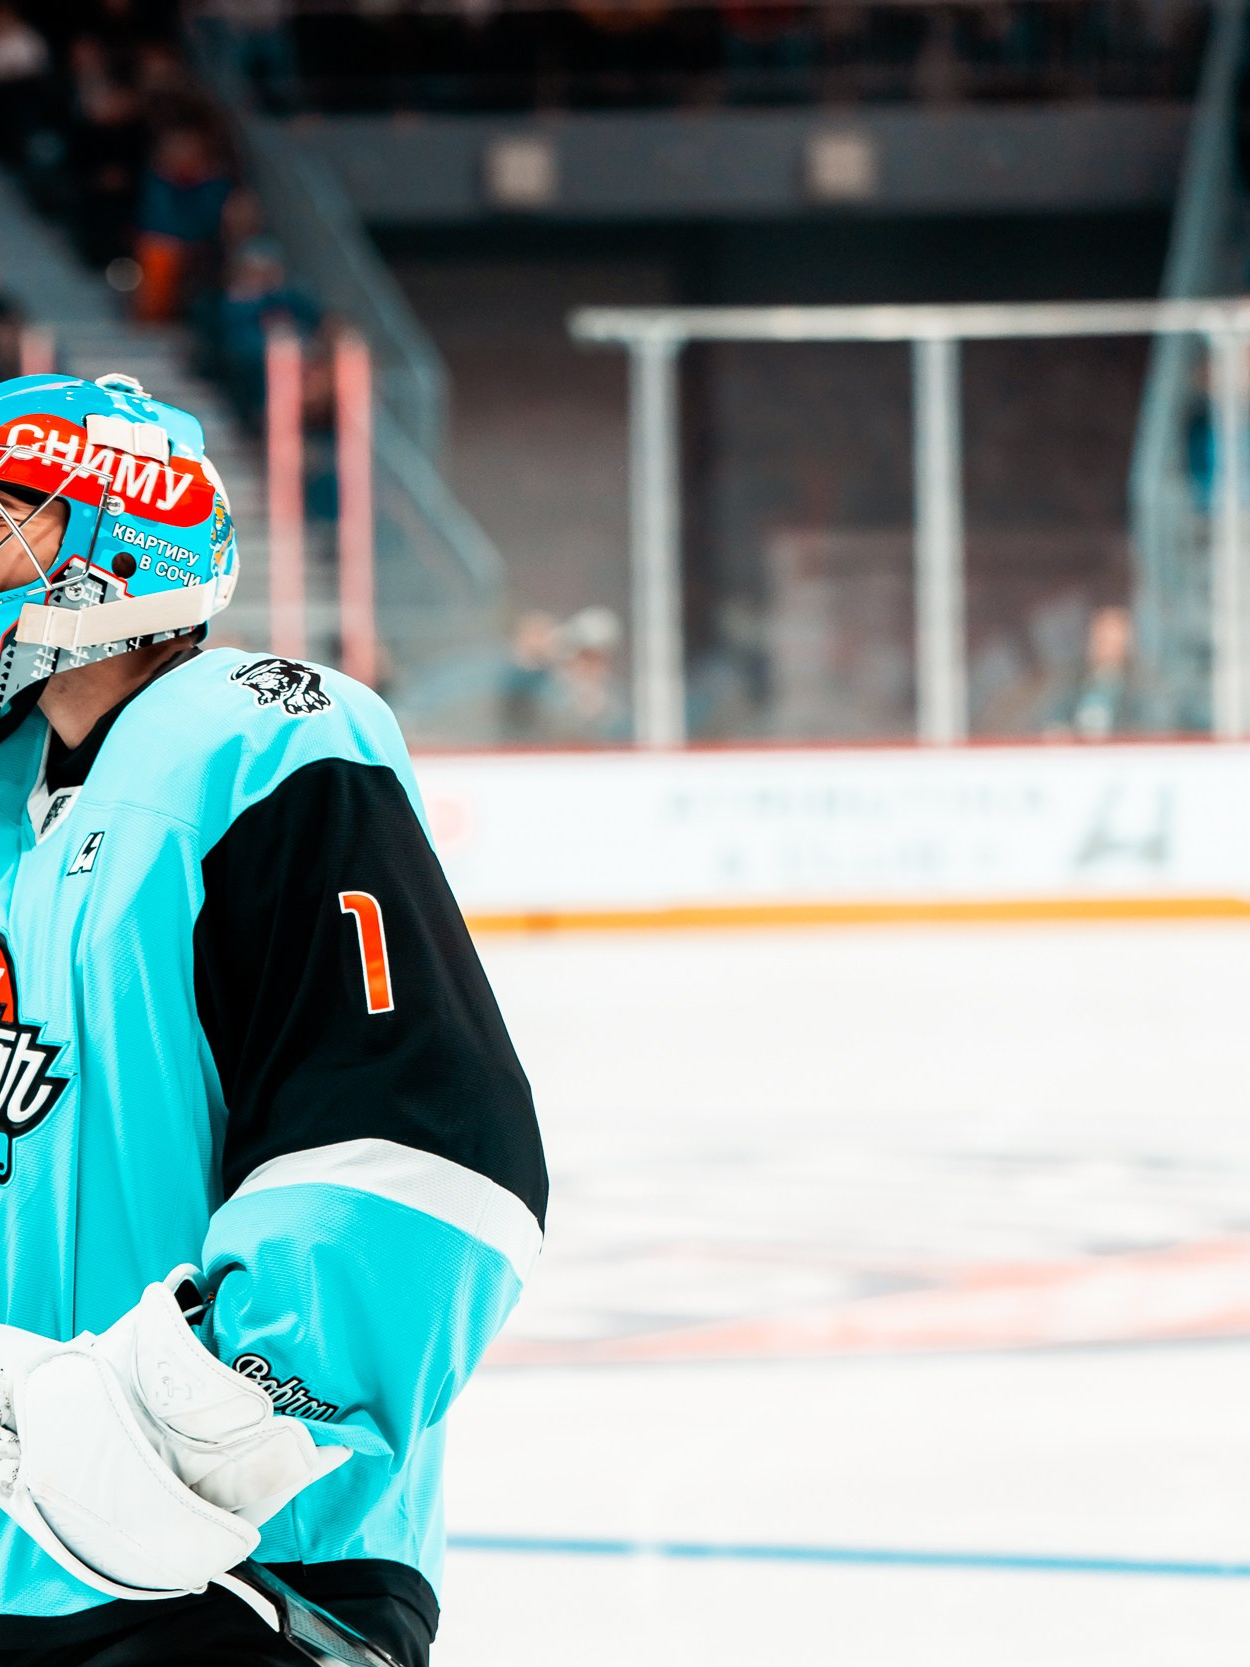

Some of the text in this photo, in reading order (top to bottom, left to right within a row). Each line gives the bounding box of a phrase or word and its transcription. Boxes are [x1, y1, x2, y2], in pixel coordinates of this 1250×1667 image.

[7, 424, 193, 511] СНИМУ
[112, 522, 200, 567] КВАРТИРУ
[139, 553, 201, 587] В СОЧИ
[338, 891, 395, 1014] 1
